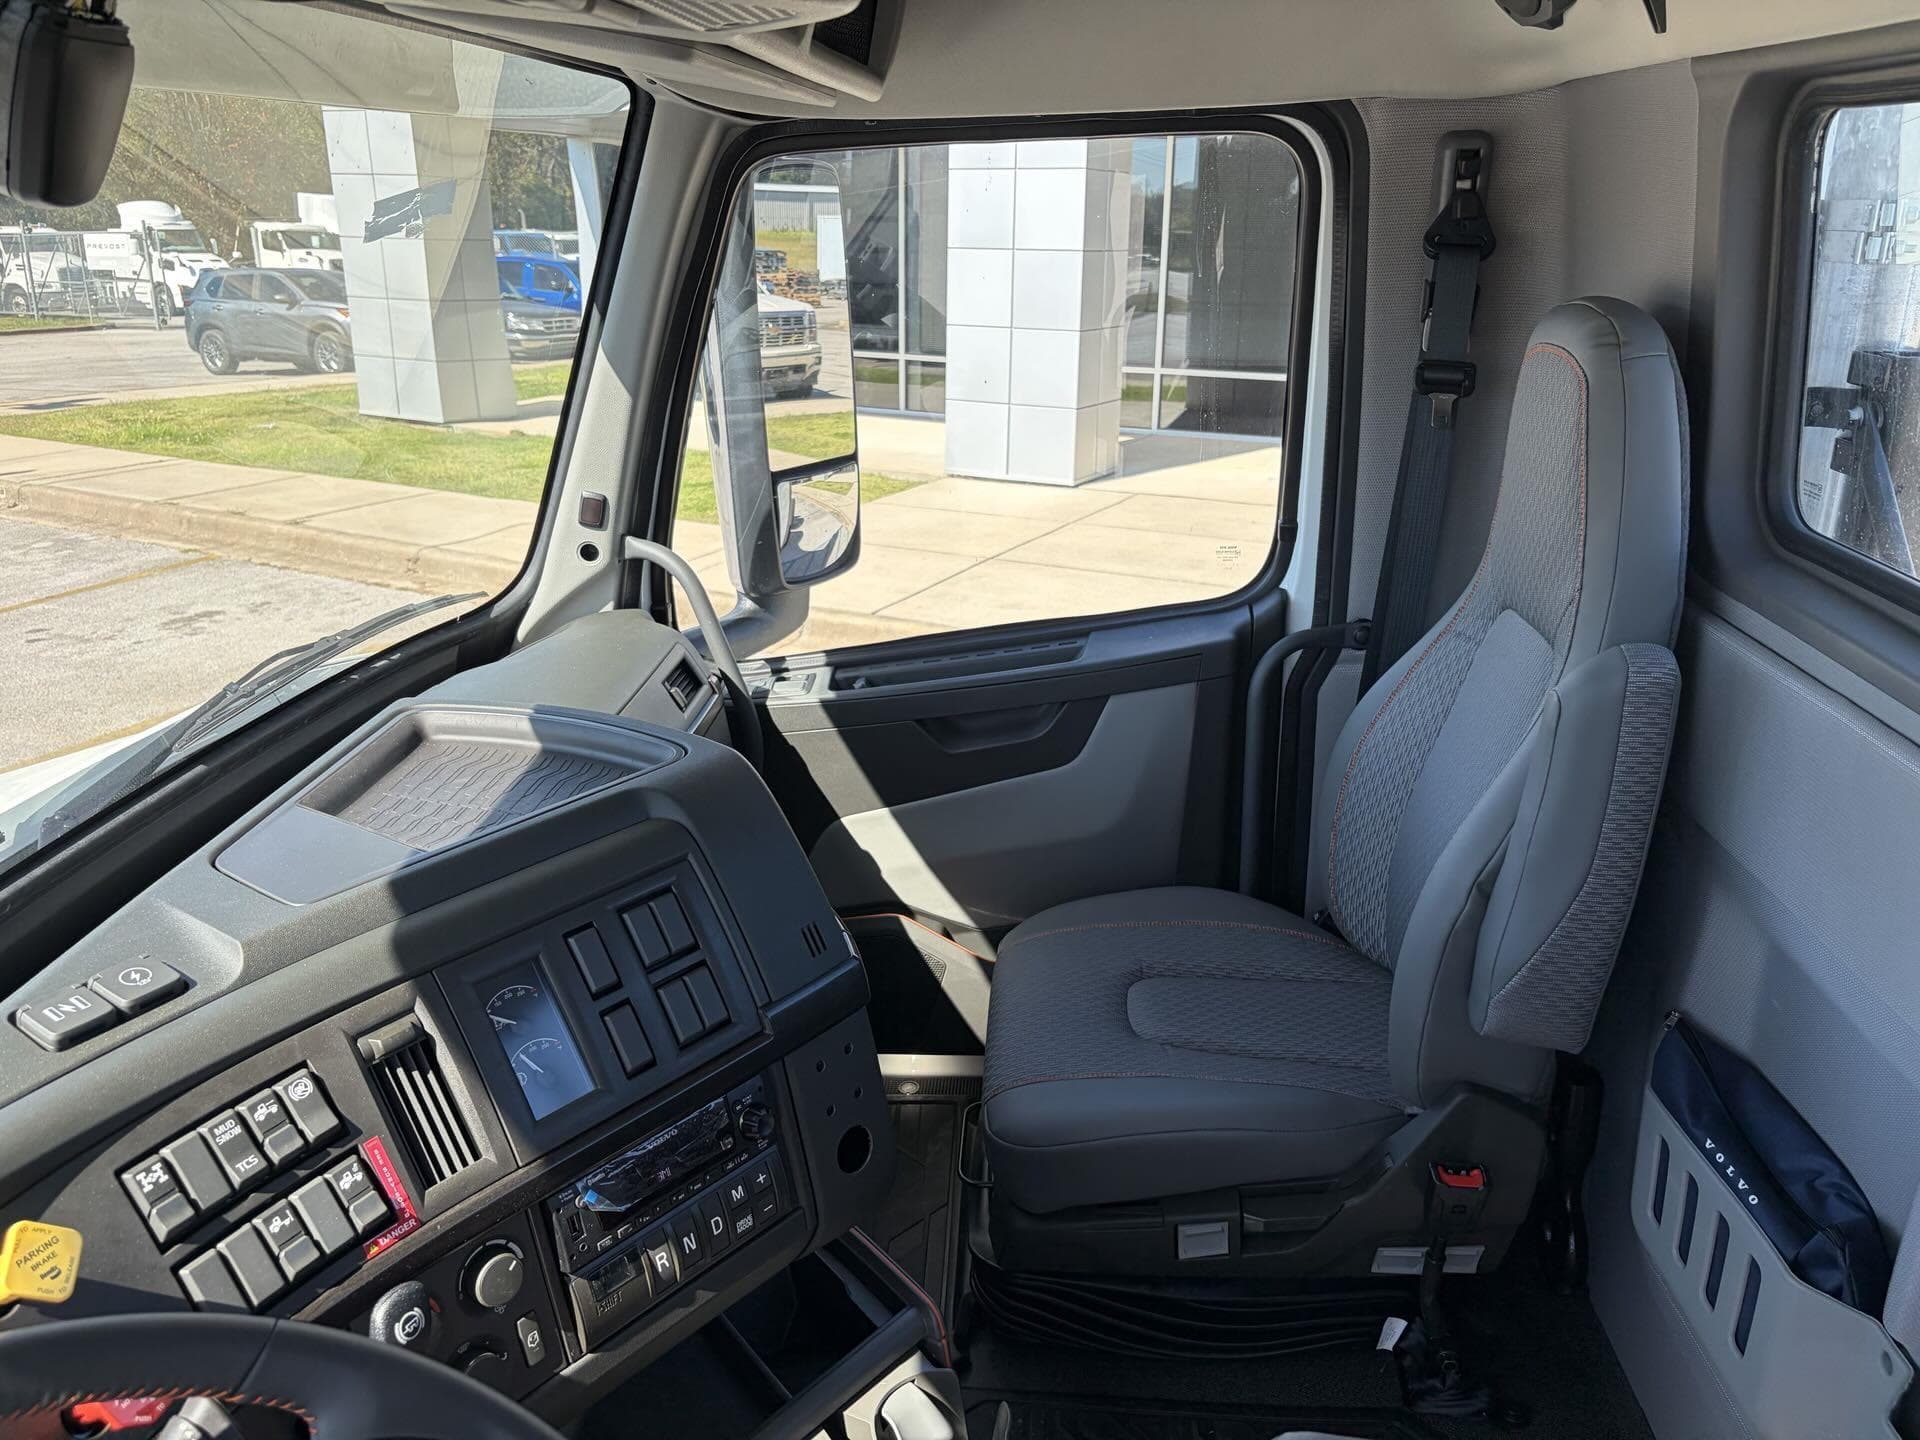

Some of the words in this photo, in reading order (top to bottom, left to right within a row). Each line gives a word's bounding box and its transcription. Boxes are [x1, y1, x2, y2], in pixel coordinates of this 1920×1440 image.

[213, 1119, 235, 1136] MUD
[216, 1125, 241, 1146] SNOW
[235, 1154, 259, 1173] TCS
[1705, 1137, 1758, 1204] VOLVO
[731, 1185, 745, 1202] M
[379, 1218, 417, 1246] DANGER
[710, 1216, 723, 1236] D
[16, 1235, 60, 1268] PARKING
[682, 1233, 697, 1254] N
[31, 1250, 58, 1271] BRAKE
[655, 1251, 670, 1272] R
